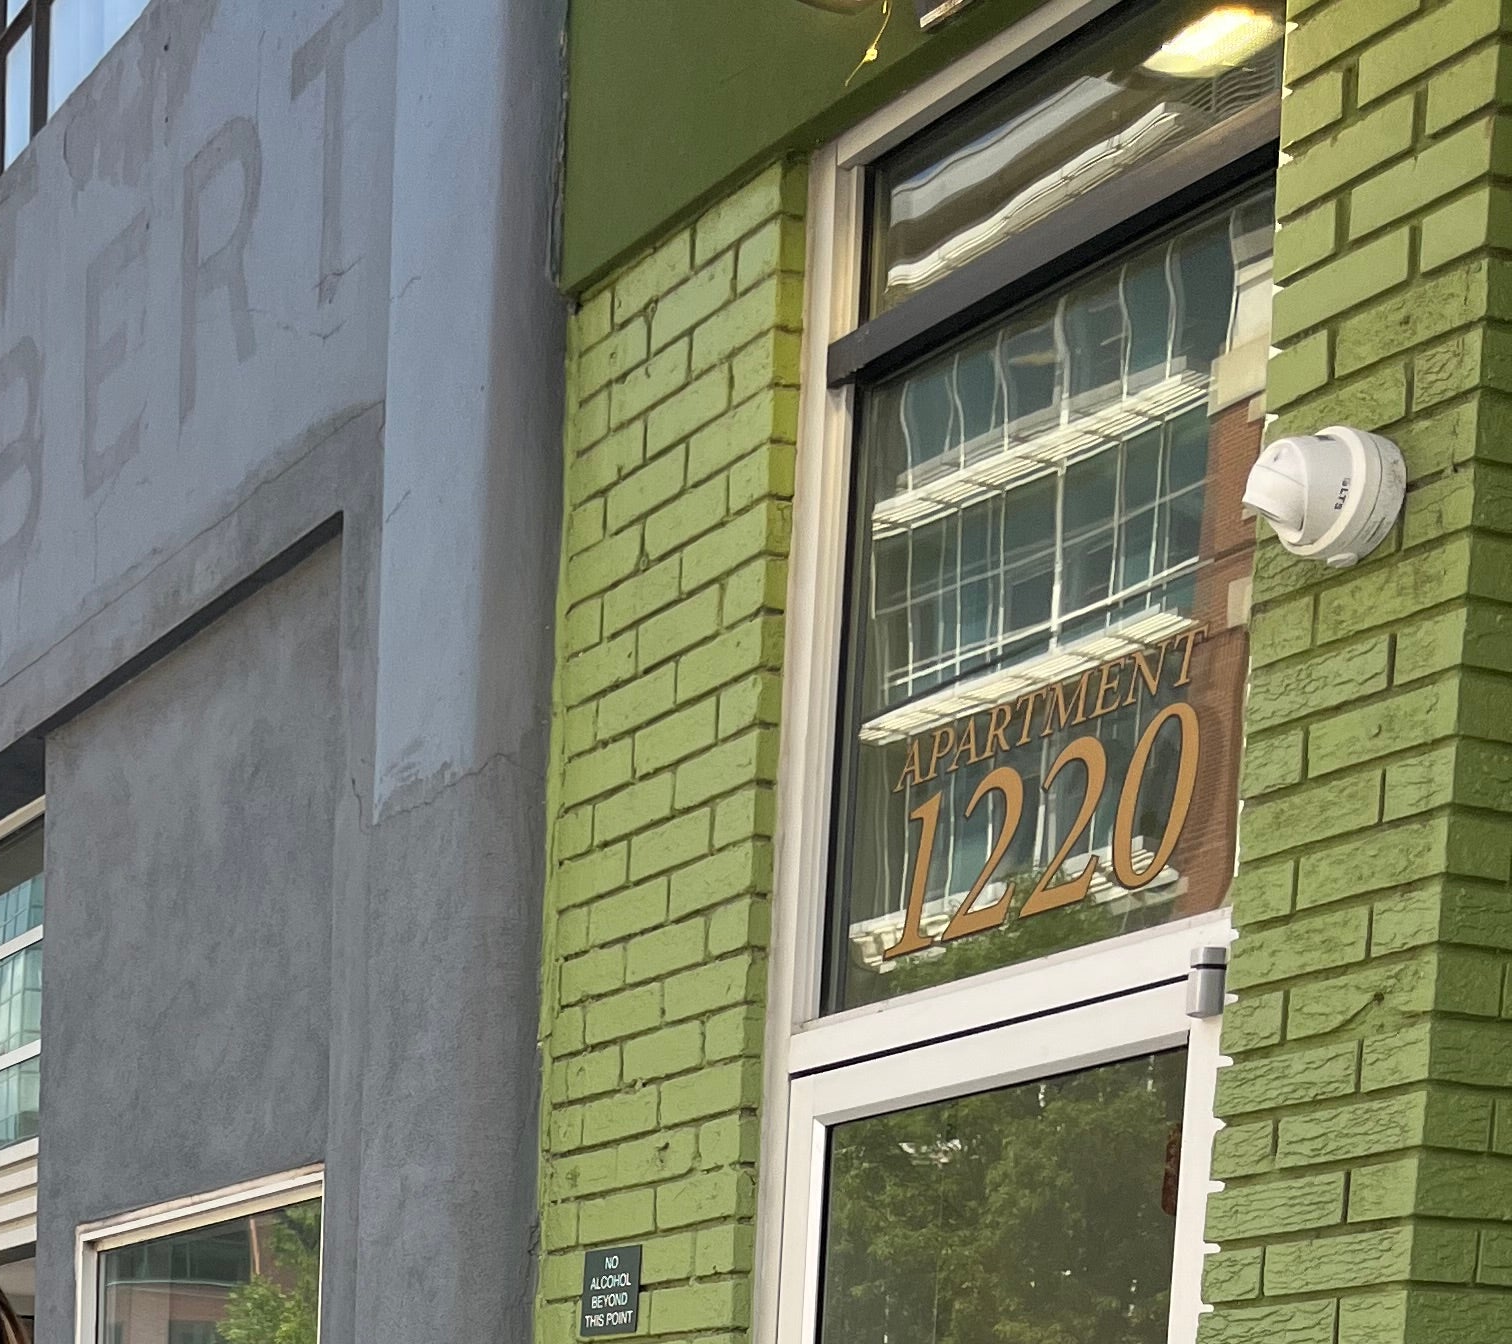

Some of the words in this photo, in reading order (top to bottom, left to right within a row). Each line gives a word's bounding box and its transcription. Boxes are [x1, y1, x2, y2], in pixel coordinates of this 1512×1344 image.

[893, 624, 1209, 793] APARTMENT
[883, 702, 1200, 961] 1220
[605, 1255, 619, 1269] NO
[590, 1273, 631, 1290] ALCOHOL
[591, 1292, 628, 1308] BEYOND
[585, 1314, 605, 1328] THIS
[605, 1310, 633, 1327] POINT
